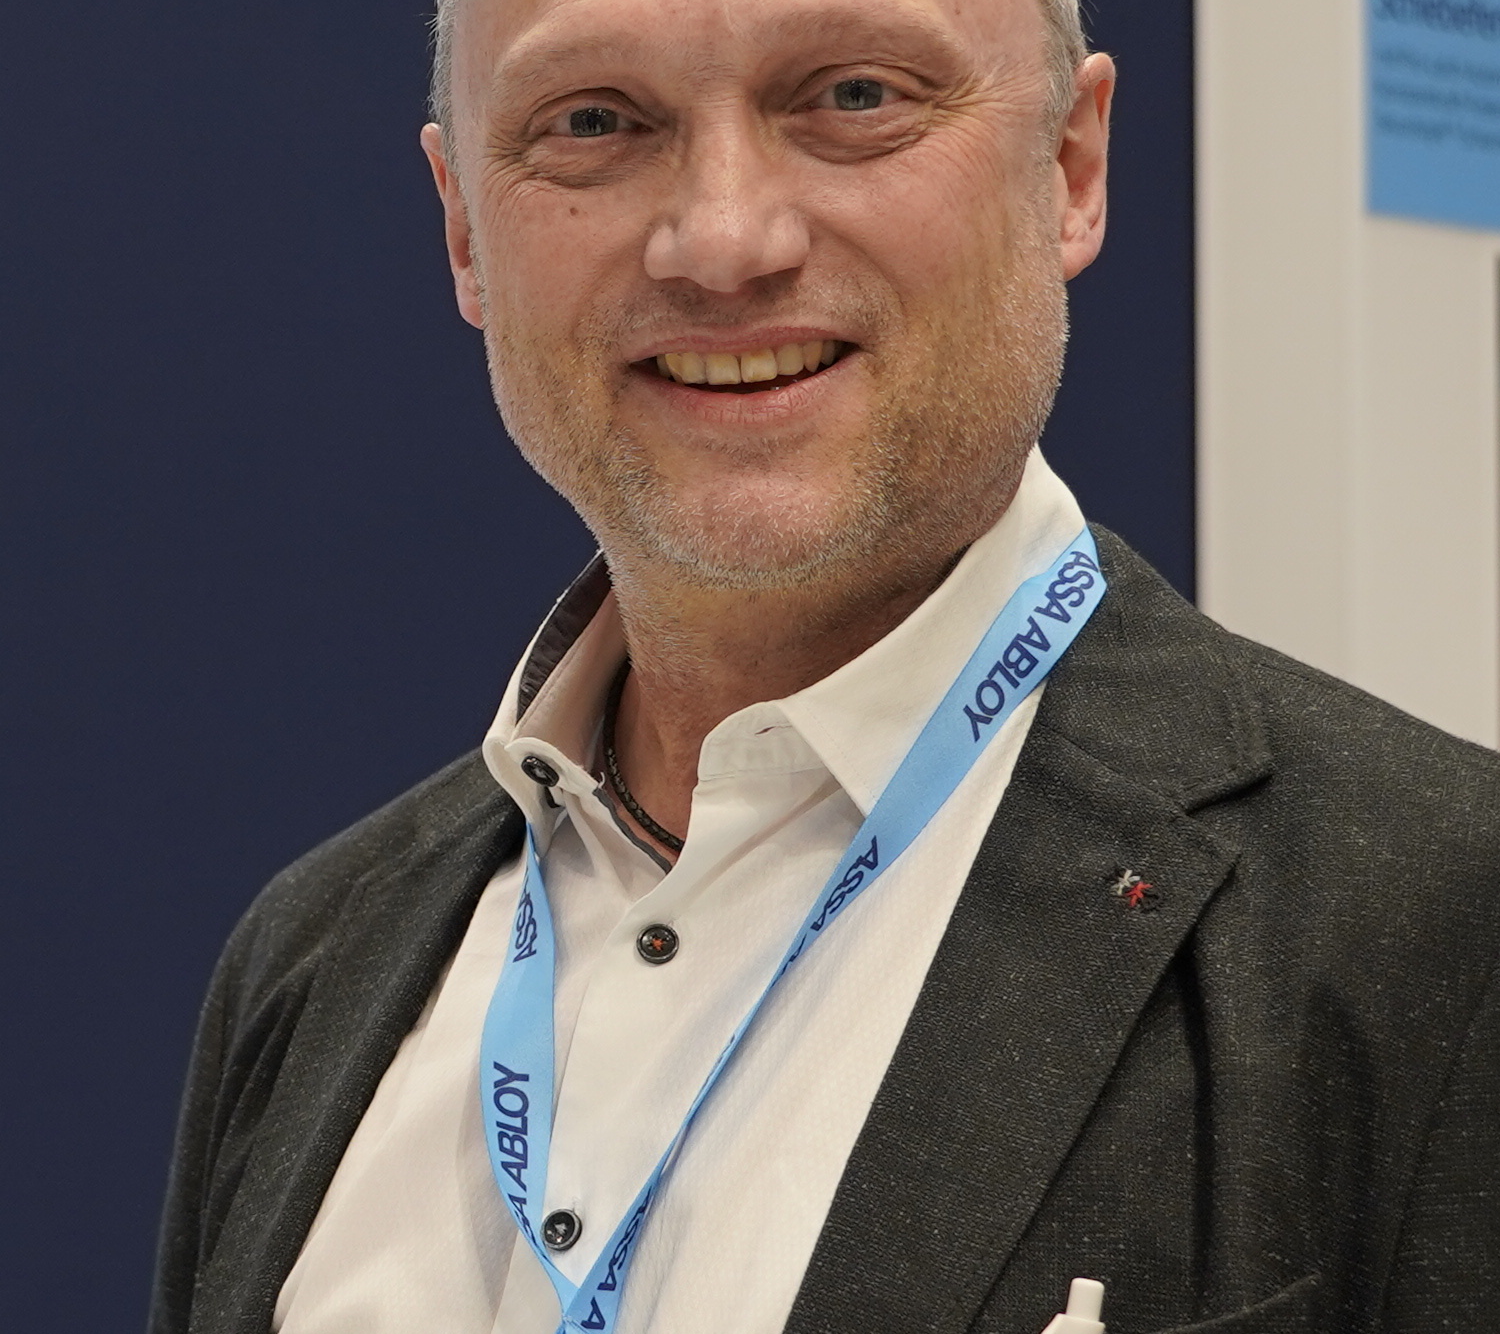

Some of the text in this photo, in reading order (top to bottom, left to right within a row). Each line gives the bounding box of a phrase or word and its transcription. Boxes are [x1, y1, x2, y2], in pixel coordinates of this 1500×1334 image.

[963, 551, 1099, 743] ASSA ABLOY
[493, 1061, 529, 1191] ABLOY
